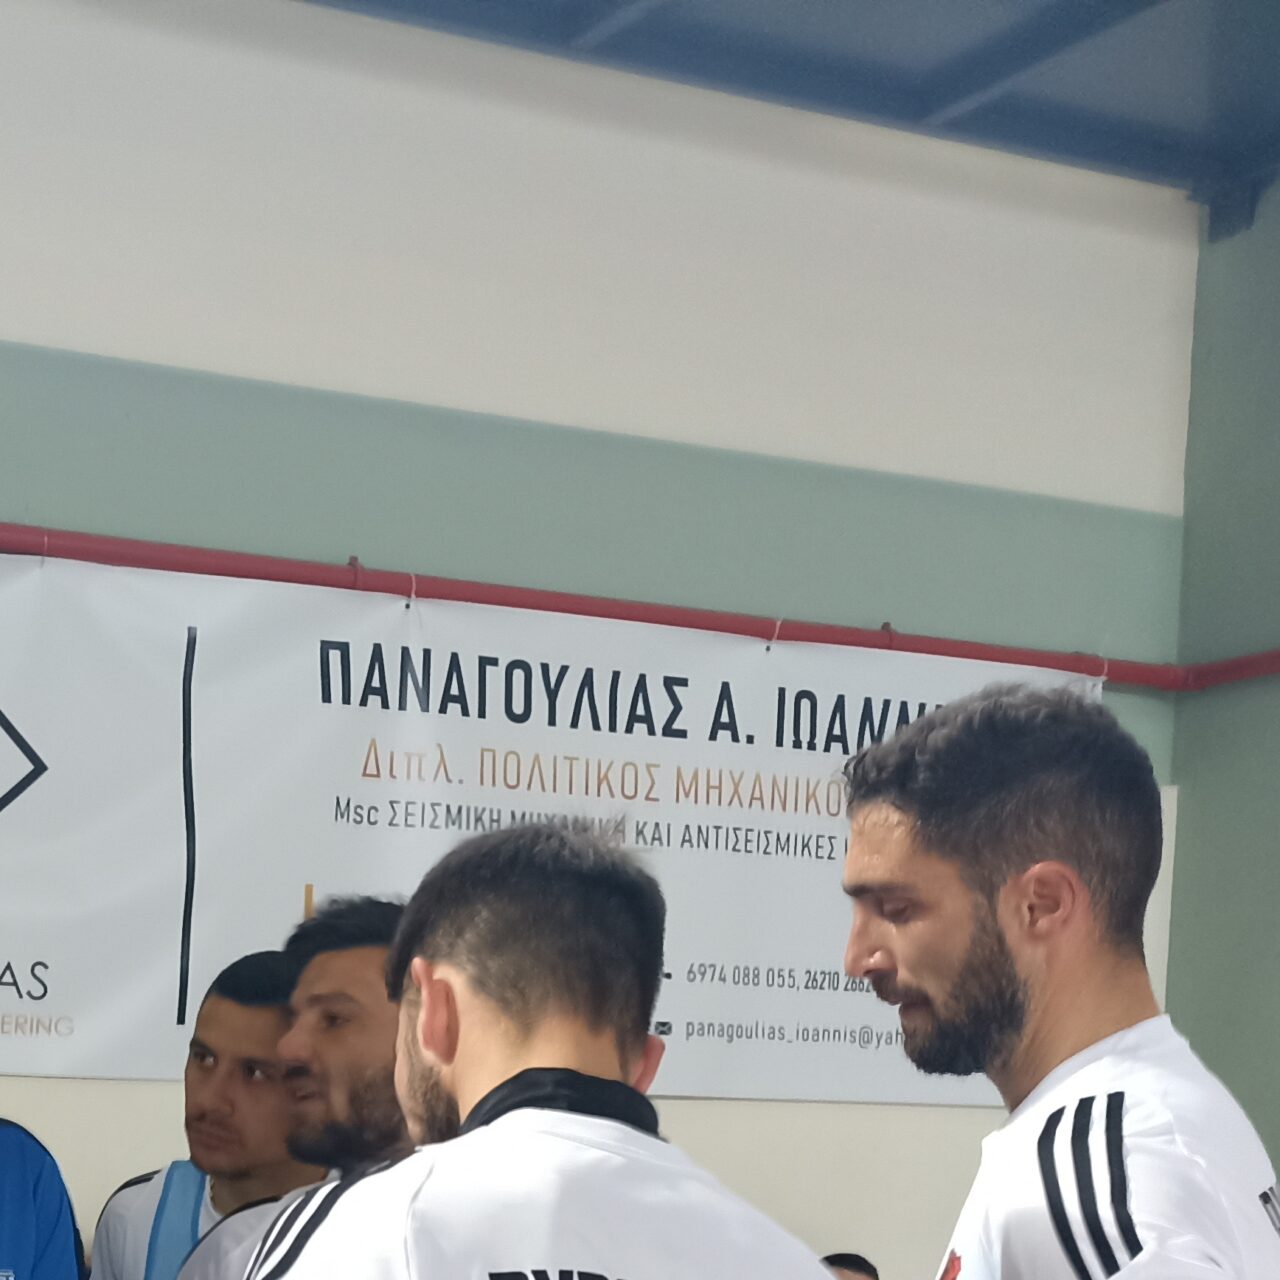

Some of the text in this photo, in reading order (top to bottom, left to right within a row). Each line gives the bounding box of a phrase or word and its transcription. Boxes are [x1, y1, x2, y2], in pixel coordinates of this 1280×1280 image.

[320, 640, 688, 739] ΠΑΝΑΓΟΥΛΙΑΣ
[708, 681, 754, 744] Α.
[361, 738, 844, 817] Διπλ. ΠΟΛΙΤΙΚΟΣ ΜΗΧΑΝΙΚΟ
[334, 796, 379, 826] Msc
[388, 800, 501, 833] ΣΕΙΣΜΙΚΗ
[636, 820, 671, 848] ΚΑΙ
[680, 825, 837, 860] ΑΝΤΙΣΕΙΣΜΙΚΕΣ
[687, 963, 726, 984] 6974
[733, 965, 760, 987] 088
[686, 1020, 903, 1050] panagoulias_ioannis@yah
